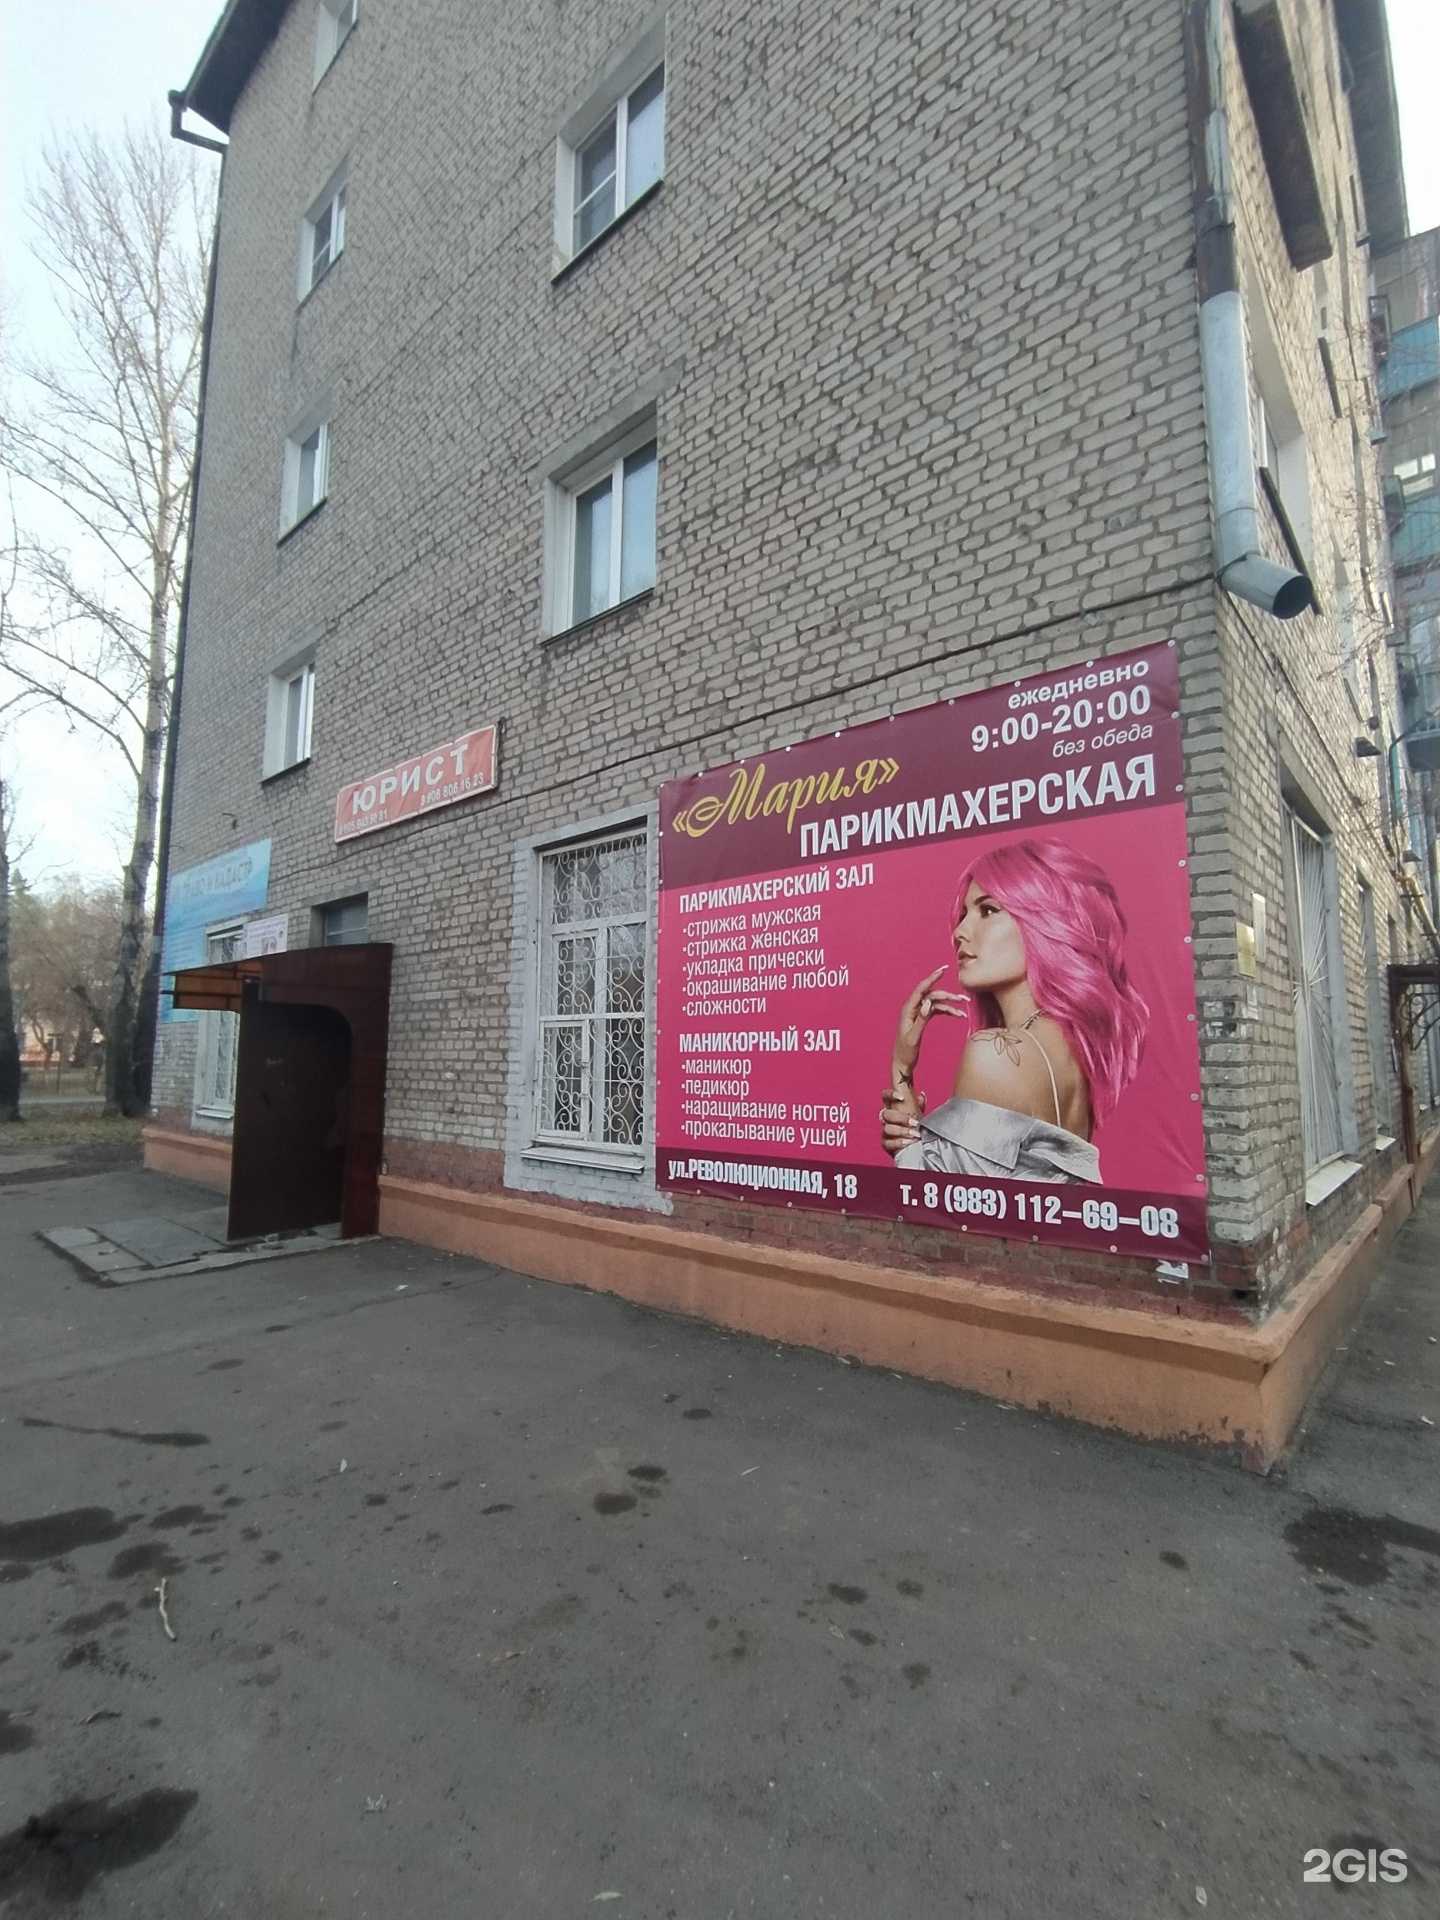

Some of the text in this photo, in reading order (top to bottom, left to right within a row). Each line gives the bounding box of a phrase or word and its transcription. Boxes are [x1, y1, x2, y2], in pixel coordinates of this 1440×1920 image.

[1008, 660, 1149, 709] ежедневно
[971, 684, 1151, 752] 9:00-20:00
[1052, 724, 1153, 758] без обеда
[352, 743, 469, 815] ЮРИСТ
[800, 753, 1156, 858] ПАРИКМАХЕРСКАЯ
[679, 863, 874, 913] ПАРИКМАХЕРСКИЙ ЗАЛ
[751, 904, 822, 932] мужская
[751, 926, 819, 950] женская
[748, 948, 825, 974] прически
[792, 965, 849, 989] любой
[679, 1025, 841, 1053] МАНИКЮРНЫЙ ЗАЛ
[792, 1102, 850, 1124] ногтей
[800, 1127, 847, 1149] ушей
[833, 1173, 858, 1199] 18
[923, 1181, 938, 1209] 8
[944, 1184, 1008, 1220] (983)
